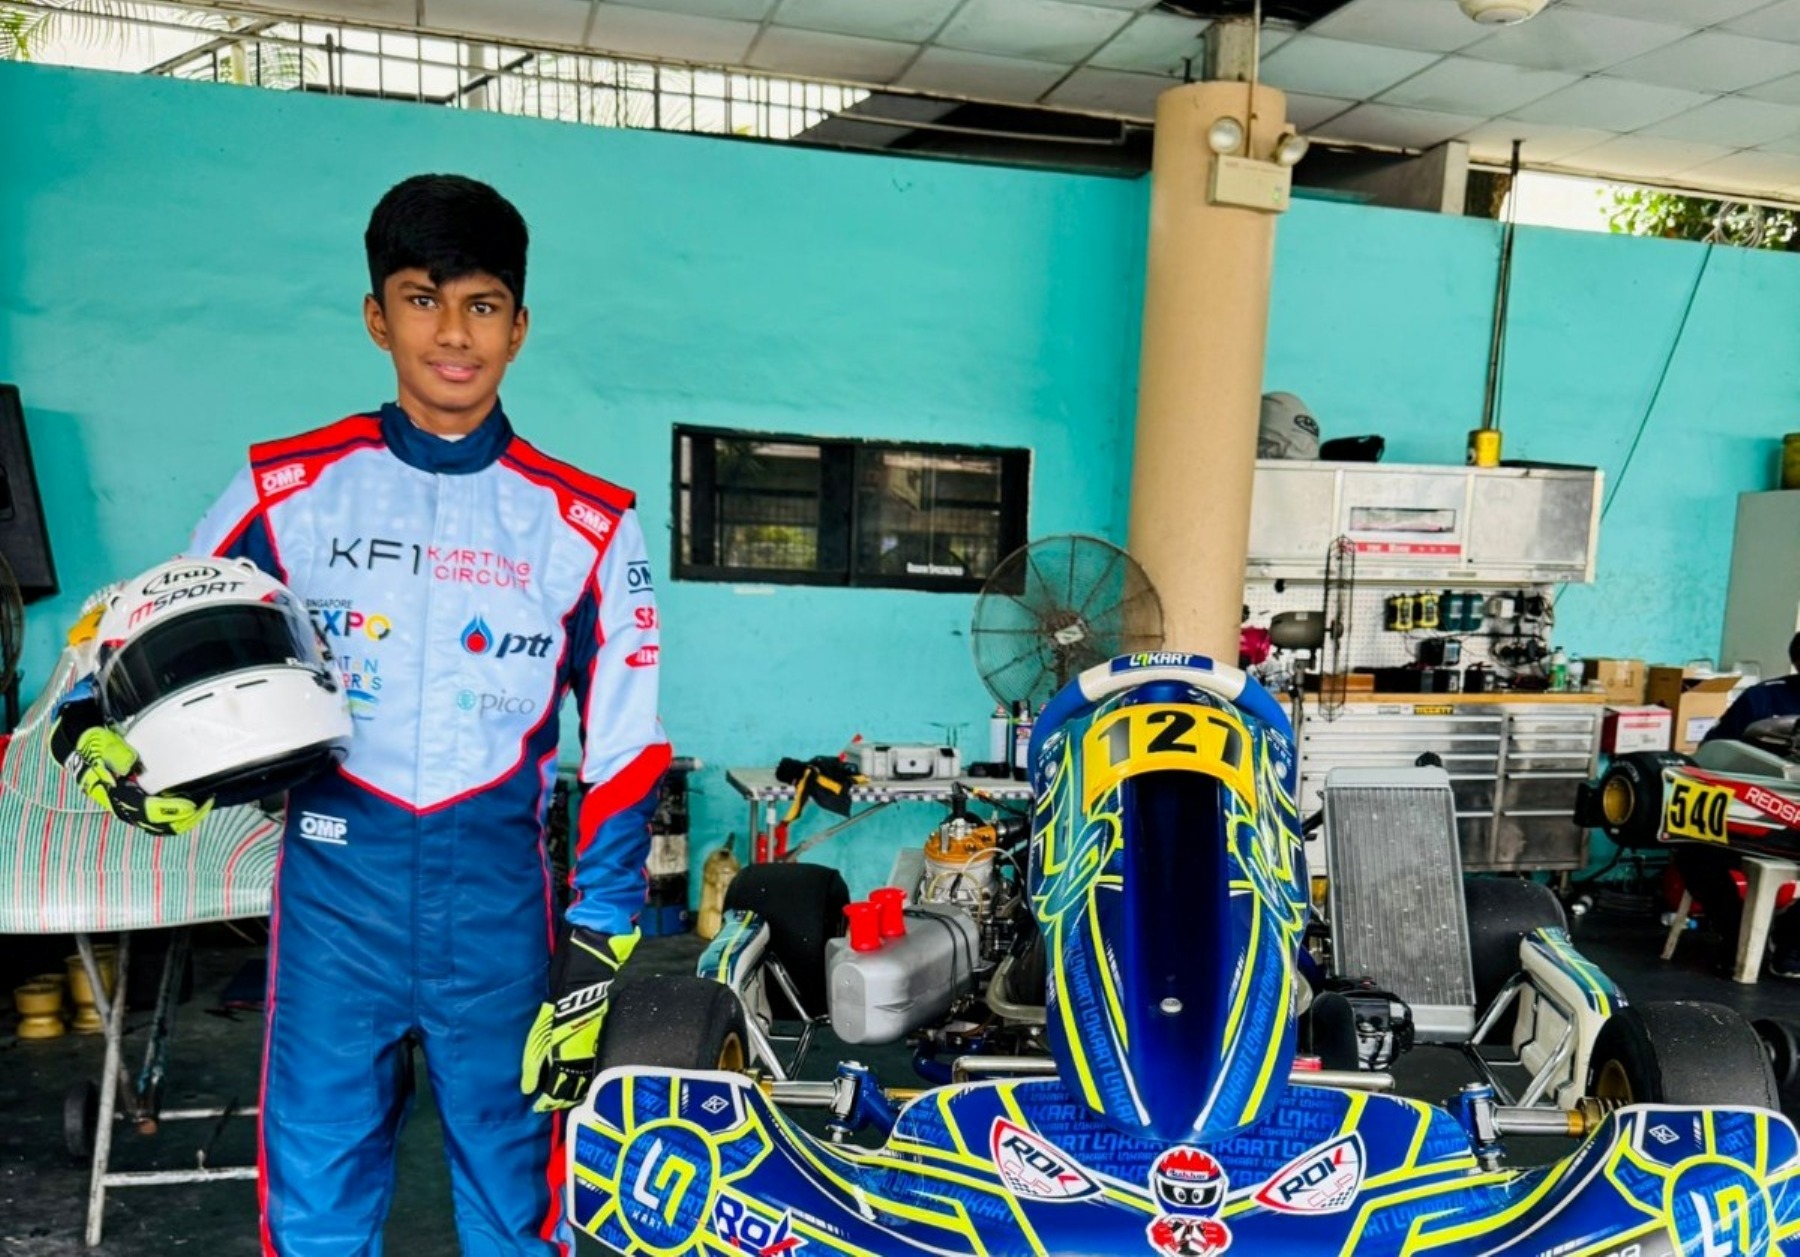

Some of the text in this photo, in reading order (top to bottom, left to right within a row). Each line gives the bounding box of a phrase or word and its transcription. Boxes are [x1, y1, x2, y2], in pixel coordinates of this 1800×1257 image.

[262, 466, 306, 492] OMP
[568, 502, 611, 536] OMP
[329, 537, 421, 576] KF1
[427, 546, 531, 577] KARTING
[434, 564, 531, 590] CIRCUIT
[495, 632, 554, 659] ptt
[479, 688, 536, 719] pico
[1097, 710, 1243, 771] 127
[1671, 784, 1728, 837] 540
[299, 815, 348, 840] OMP
